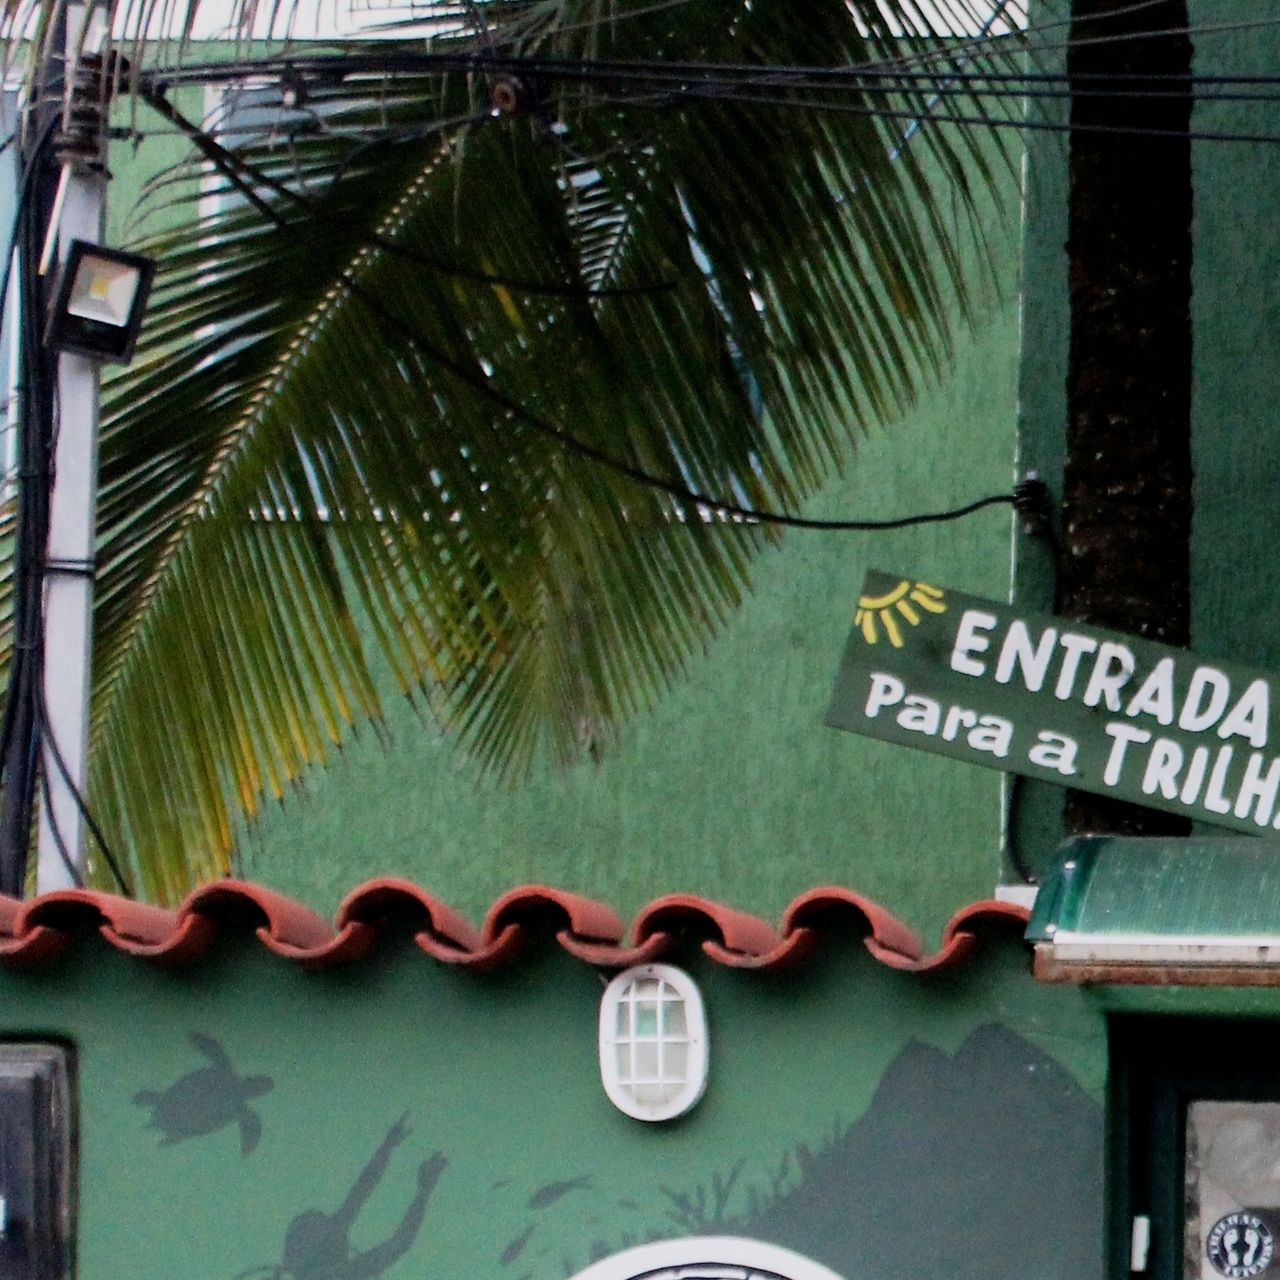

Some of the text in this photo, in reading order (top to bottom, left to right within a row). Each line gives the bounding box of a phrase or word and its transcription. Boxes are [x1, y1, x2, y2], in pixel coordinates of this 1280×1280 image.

[864, 672, 1014, 758] Para
[1028, 730, 1079, 776] a
[950, 610, 1272, 748] ENTRADA
